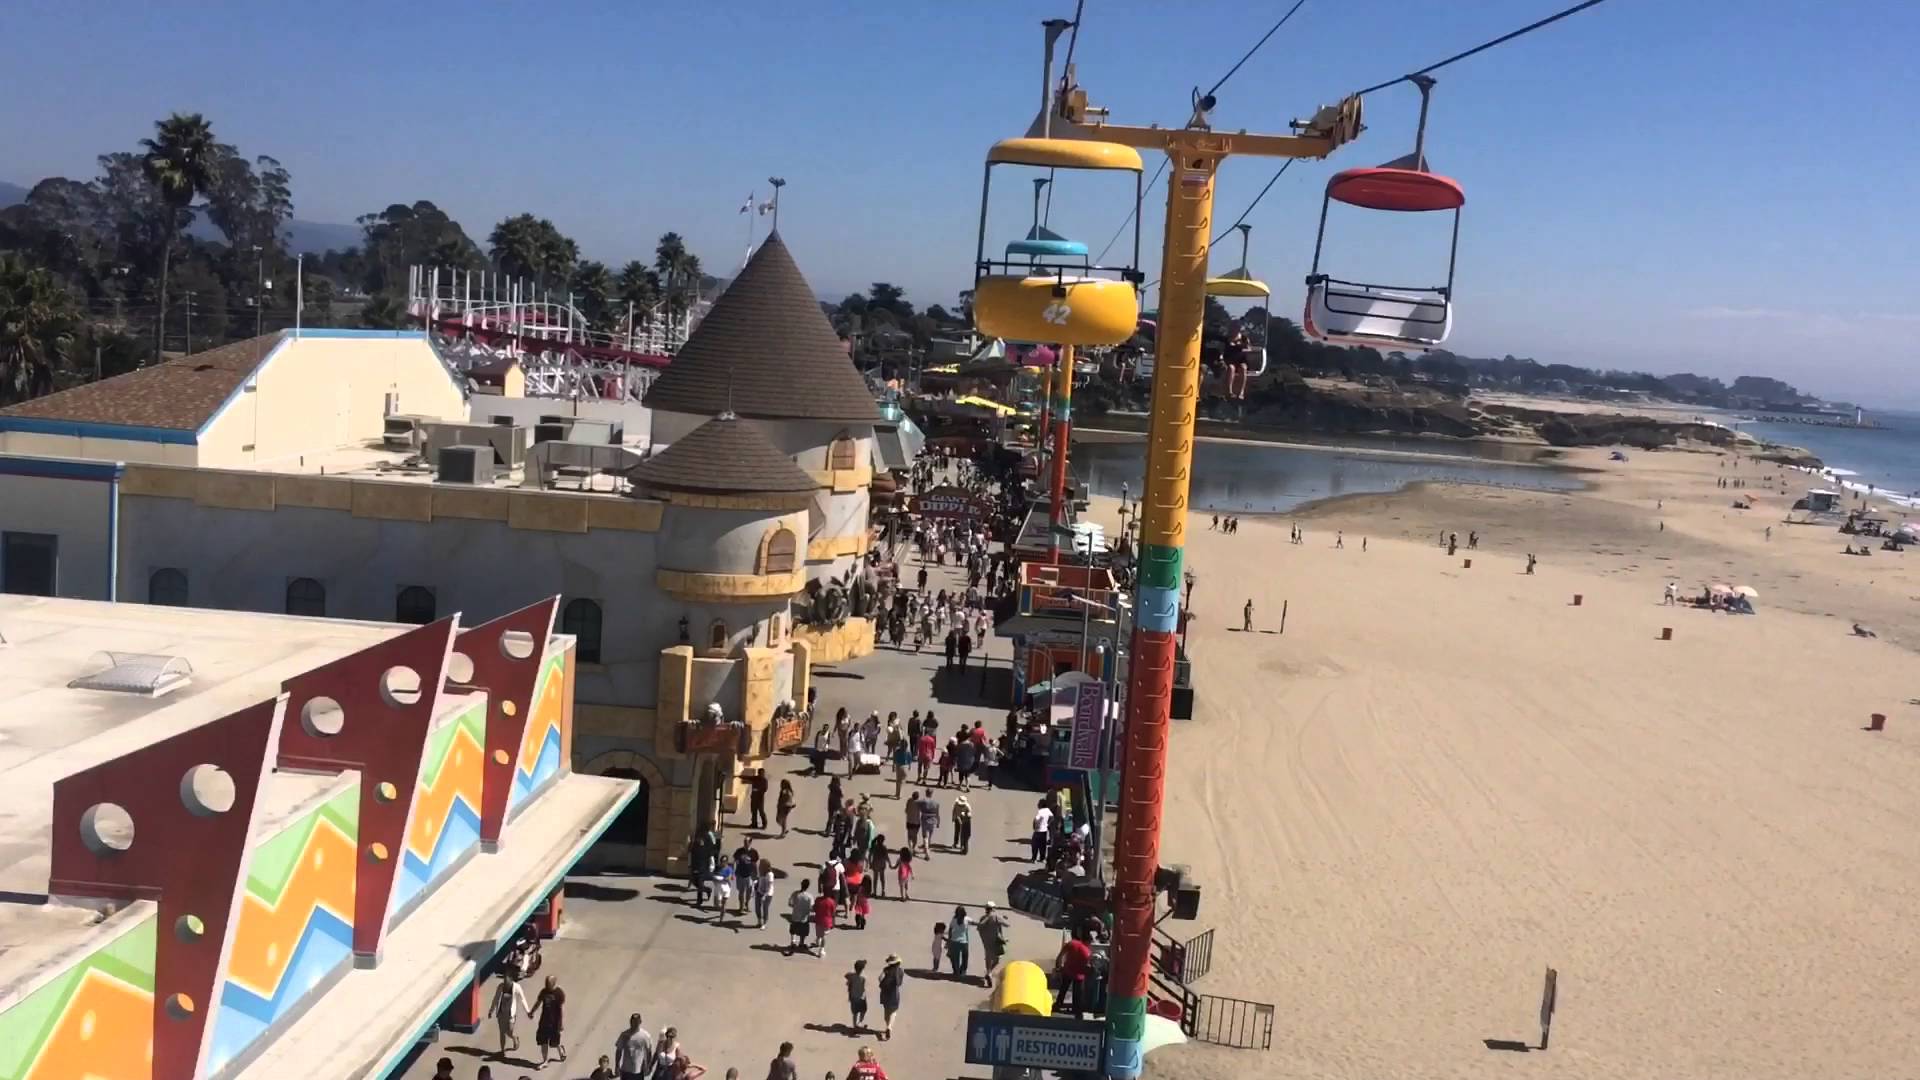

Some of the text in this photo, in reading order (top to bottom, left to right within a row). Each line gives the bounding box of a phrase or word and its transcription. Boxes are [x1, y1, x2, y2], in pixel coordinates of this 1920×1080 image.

[1042, 304, 1072, 326] 42
[919, 501, 981, 515] DIPPER
[1074, 685, 1101, 766] Boardwalk
[1016, 1039, 1097, 1059] RESTROOMS
